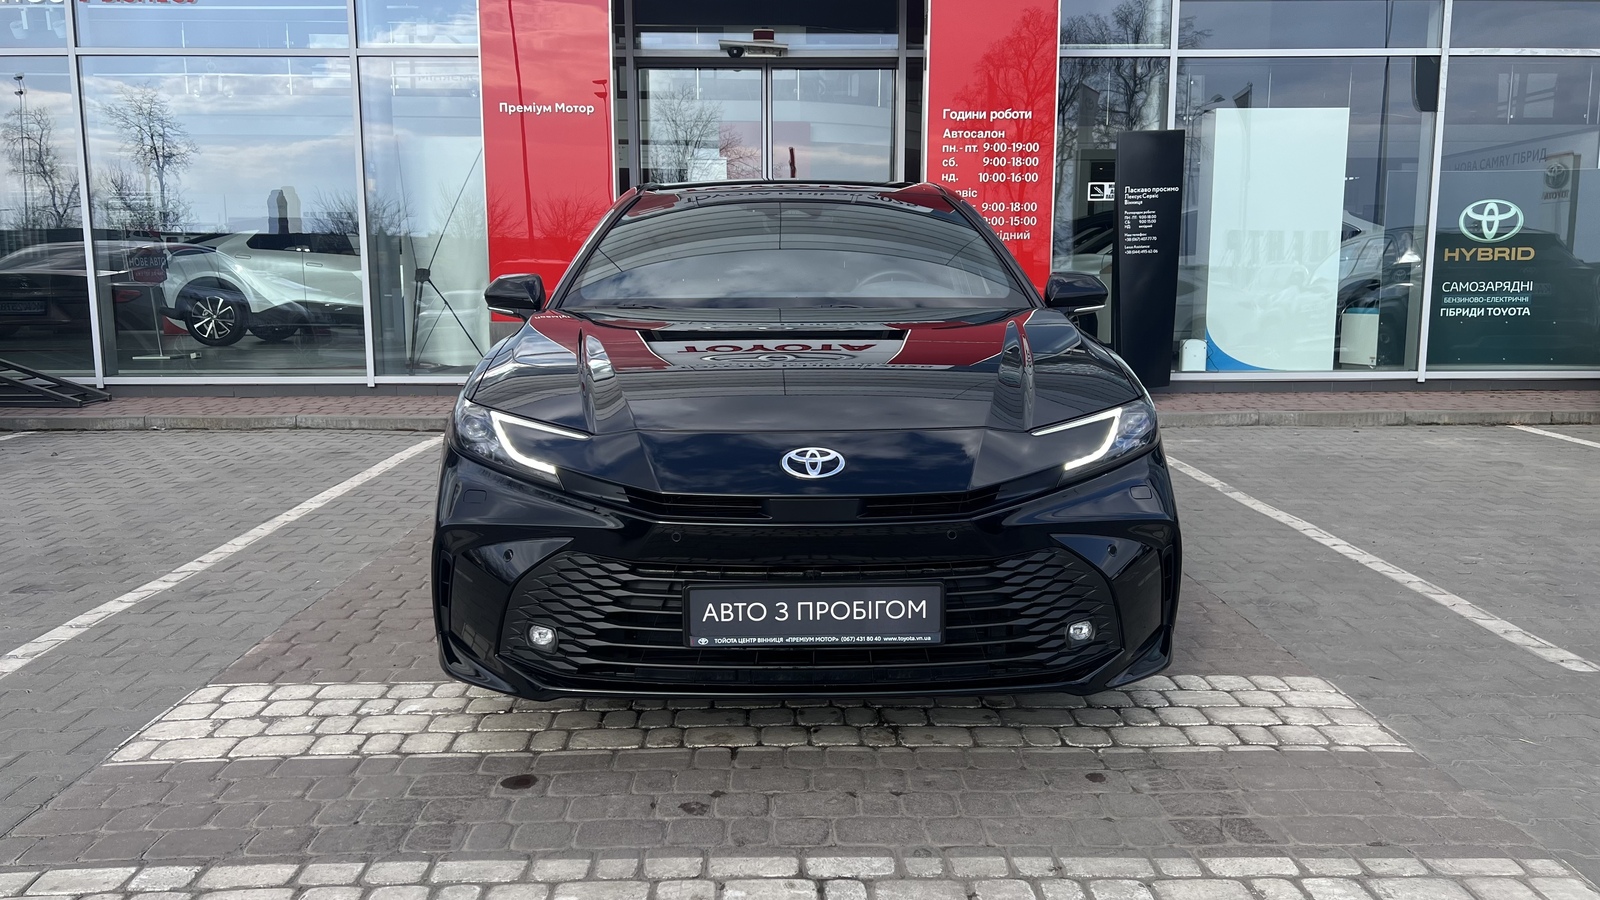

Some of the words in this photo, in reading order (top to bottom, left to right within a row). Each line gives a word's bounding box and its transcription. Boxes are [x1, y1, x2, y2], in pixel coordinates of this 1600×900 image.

[499, 102, 552, 115] Преміум
[555, 102, 595, 115] Мотор
[942, 108, 986, 121] Години
[989, 108, 1032, 122] роботи
[942, 128, 1005, 139] Автосалон
[983, 142, 1040, 153] 9:00-19:00
[942, 157, 958, 167] сб.
[982, 156, 1039, 167] 9:00-18:00
[1480, 156, 1511, 170] CAMRY
[1512, 148, 1547, 163] ГІБРИД
[941, 172, 959, 183] нд.
[978, 172, 1039, 183] 10:00-16:00
[1152, 186, 1180, 194] просимо
[981, 202, 1038, 212] 9:00-18:00
[995, 229, 1031, 241] ідний
[1443, 247, 1537, 262] HYBRID
[1441, 280, 1534, 294] САМОЗАРЯДНІ
[1443, 296, 1530, 304] БЕНЗИНОВО-ЕЛЕКТРИЧНІ
[1439, 307, 1485, 319] ГІБРИДИ
[1486, 306, 1531, 317] TOYOTA
[702, 602, 767, 623] АВТО
[774, 601, 789, 622] З
[797, 599, 927, 621] ПРОБІГОМ
[714, 637, 737, 645] ТОЙОТА
[738, 637, 756, 645] ЦЕНТР
[757, 637, 784, 645] ВІННИЦЯ
[840, 635, 855, 643] (067)
[883, 635, 932, 643] www.toyota.vn.ua
